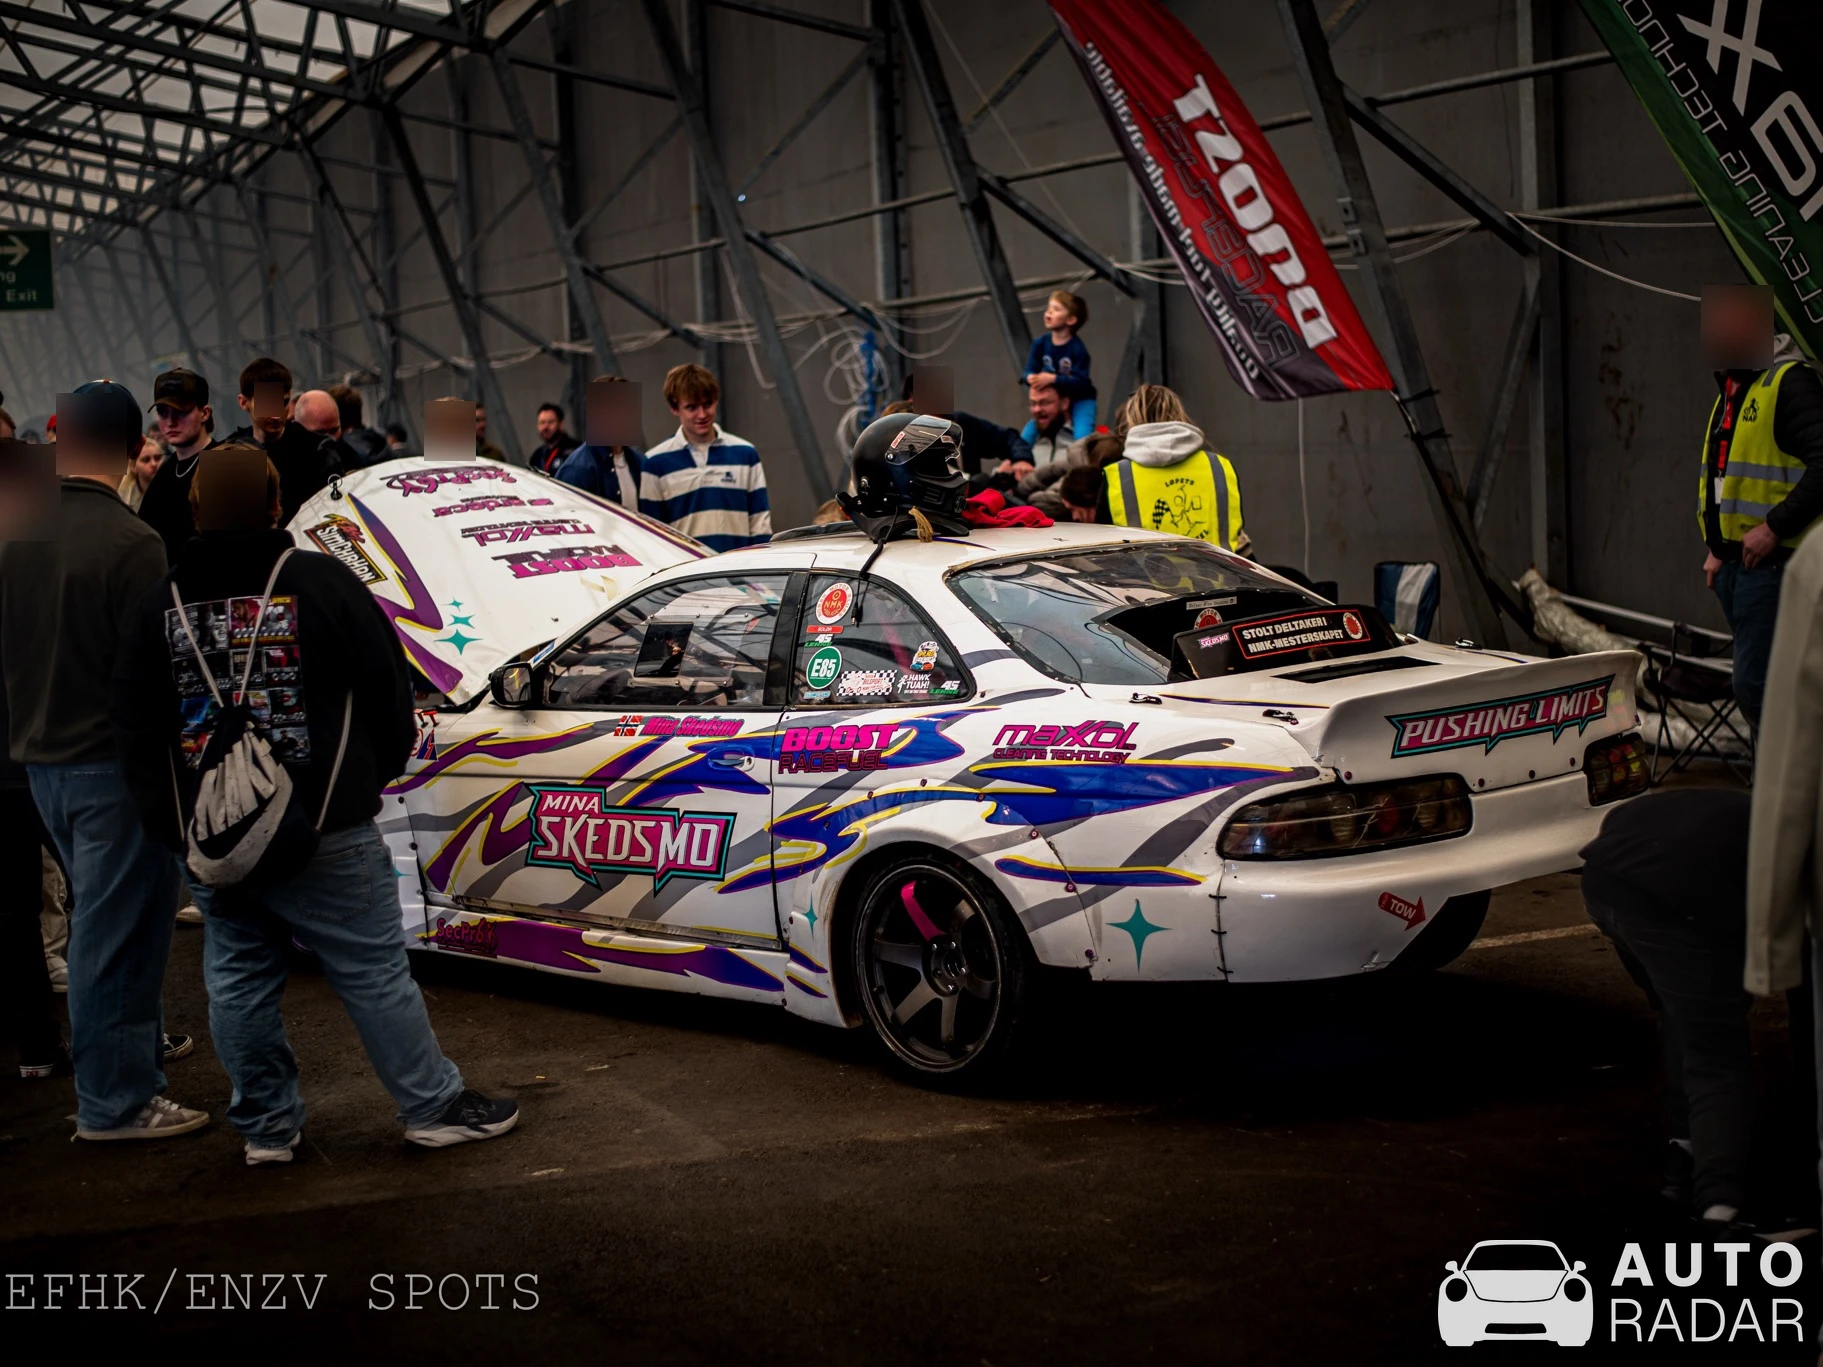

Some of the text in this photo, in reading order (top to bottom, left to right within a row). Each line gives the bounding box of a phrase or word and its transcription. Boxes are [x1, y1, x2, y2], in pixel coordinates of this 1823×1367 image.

[5, 288, 39, 303] Exit
[1742, 414, 1758, 423] NAF
[507, 555, 643, 579] BOOST
[823, 600, 844, 609] NMK
[1241, 626, 1275, 640] STOLT
[1275, 617, 1322, 635] DELTAKER
[1248, 629, 1344, 653] NMK-MESTERSKAPET
[810, 658, 838, 677] E85
[909, 673, 931, 681] HAWK
[906, 681, 930, 689] TUAH!
[638, 715, 745, 737] Mina Skedsmo
[1400, 683, 1607, 748] PUSHING LIMITS
[781, 723, 901, 754] BOOST
[777, 748, 890, 775] RACEFUEL
[993, 747, 1132, 764] CLEANING TECHNOLOGY
[541, 794, 600, 815] MINA
[537, 814, 721, 870] SKEDSMO
[1390, 898, 1417, 919] TOW
